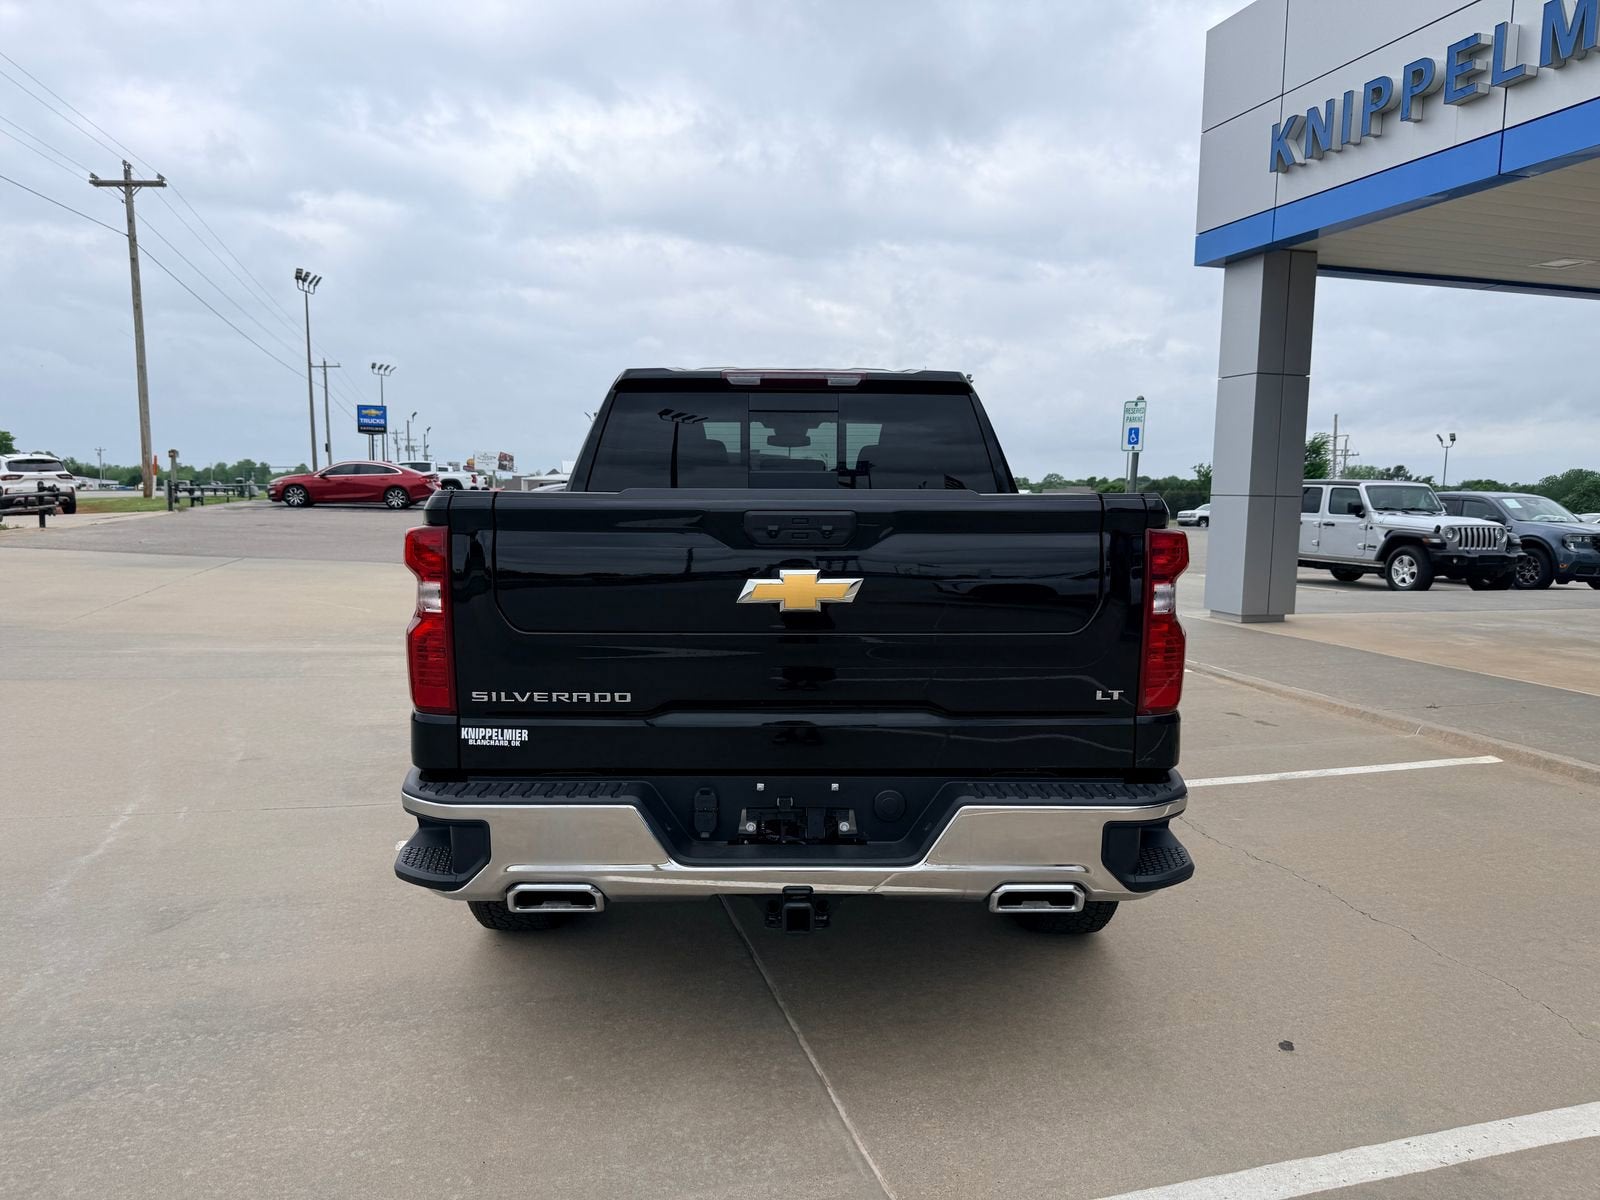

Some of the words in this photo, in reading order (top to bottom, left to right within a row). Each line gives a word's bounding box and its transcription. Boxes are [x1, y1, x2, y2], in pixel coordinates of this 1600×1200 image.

[1125, 407, 1145, 415] RESERVED
[471, 691, 632, 703] SILVERADO
[1096, 690, 1124, 701] LT
[461, 727, 529, 741] KNIPPELMIER
[468, 739, 511, 747] BLANCHARD,
